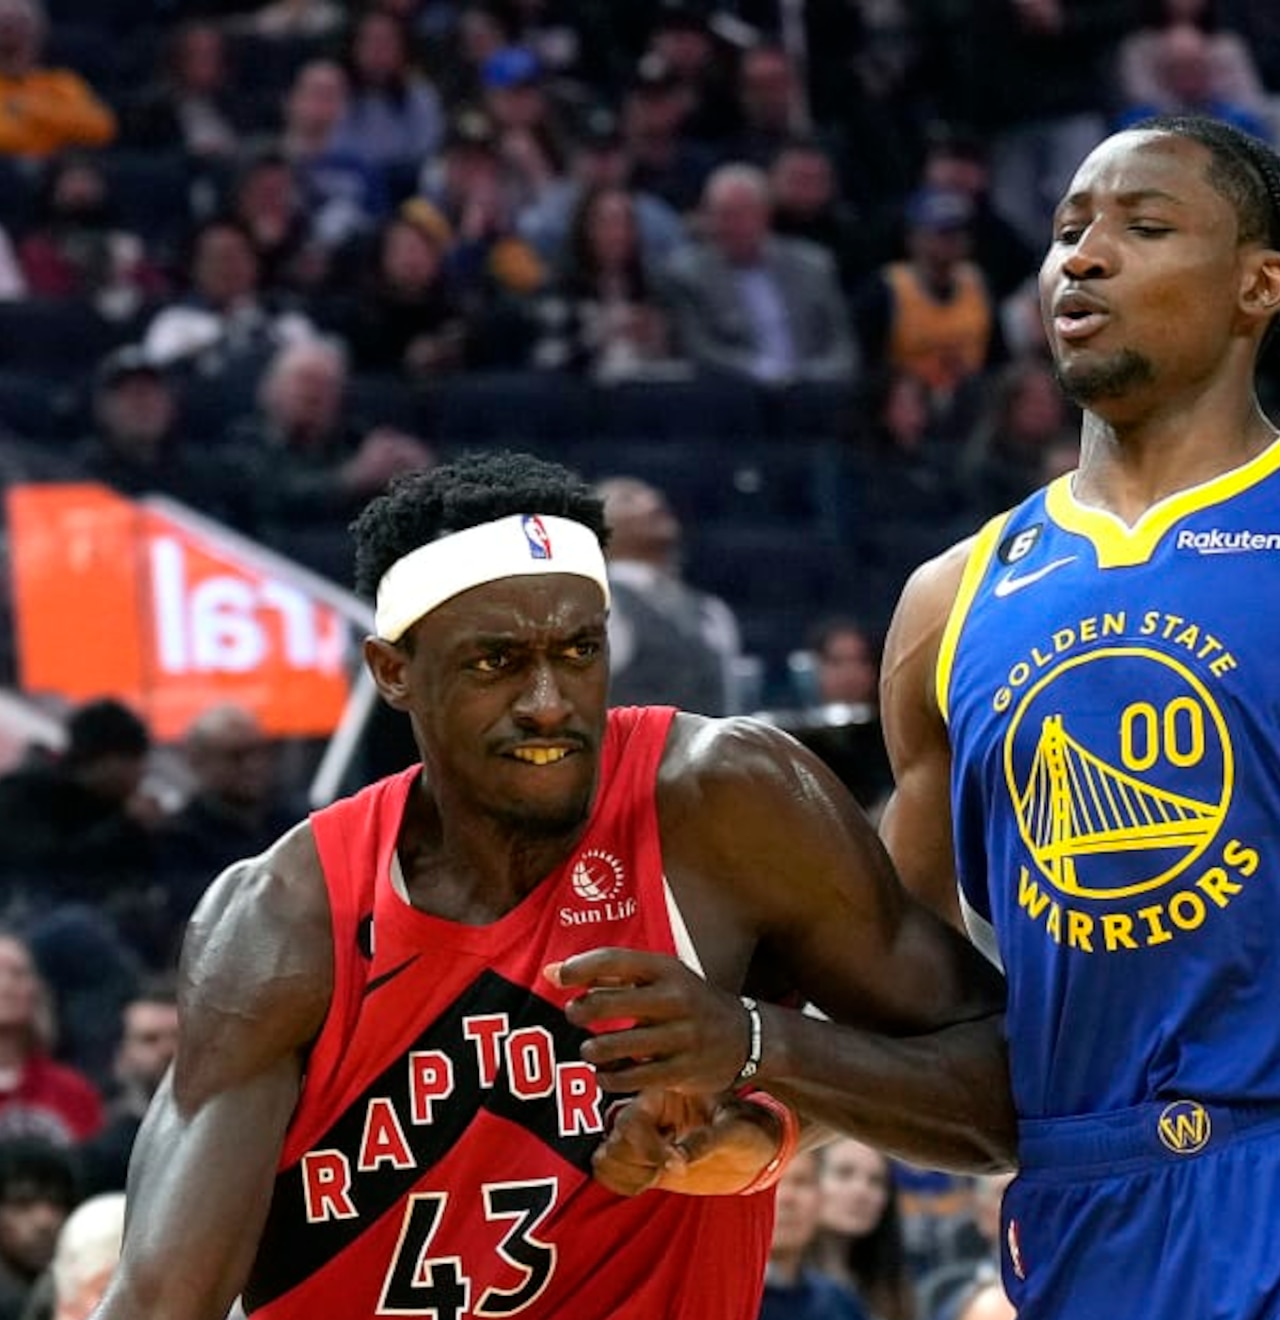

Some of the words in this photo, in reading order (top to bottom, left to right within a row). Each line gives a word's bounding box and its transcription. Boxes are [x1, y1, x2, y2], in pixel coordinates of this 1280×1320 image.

[1007, 527, 1038, 563] 6
[993, 611, 1126, 713] GOLDEN
[1140, 611, 1237, 678] STATE
[1121, 696, 1205, 772] 00
[560, 907, 601, 927] Sun
[1018, 838, 1260, 953] WARRIORS
[301, 1012, 632, 1222] RAPTOR
